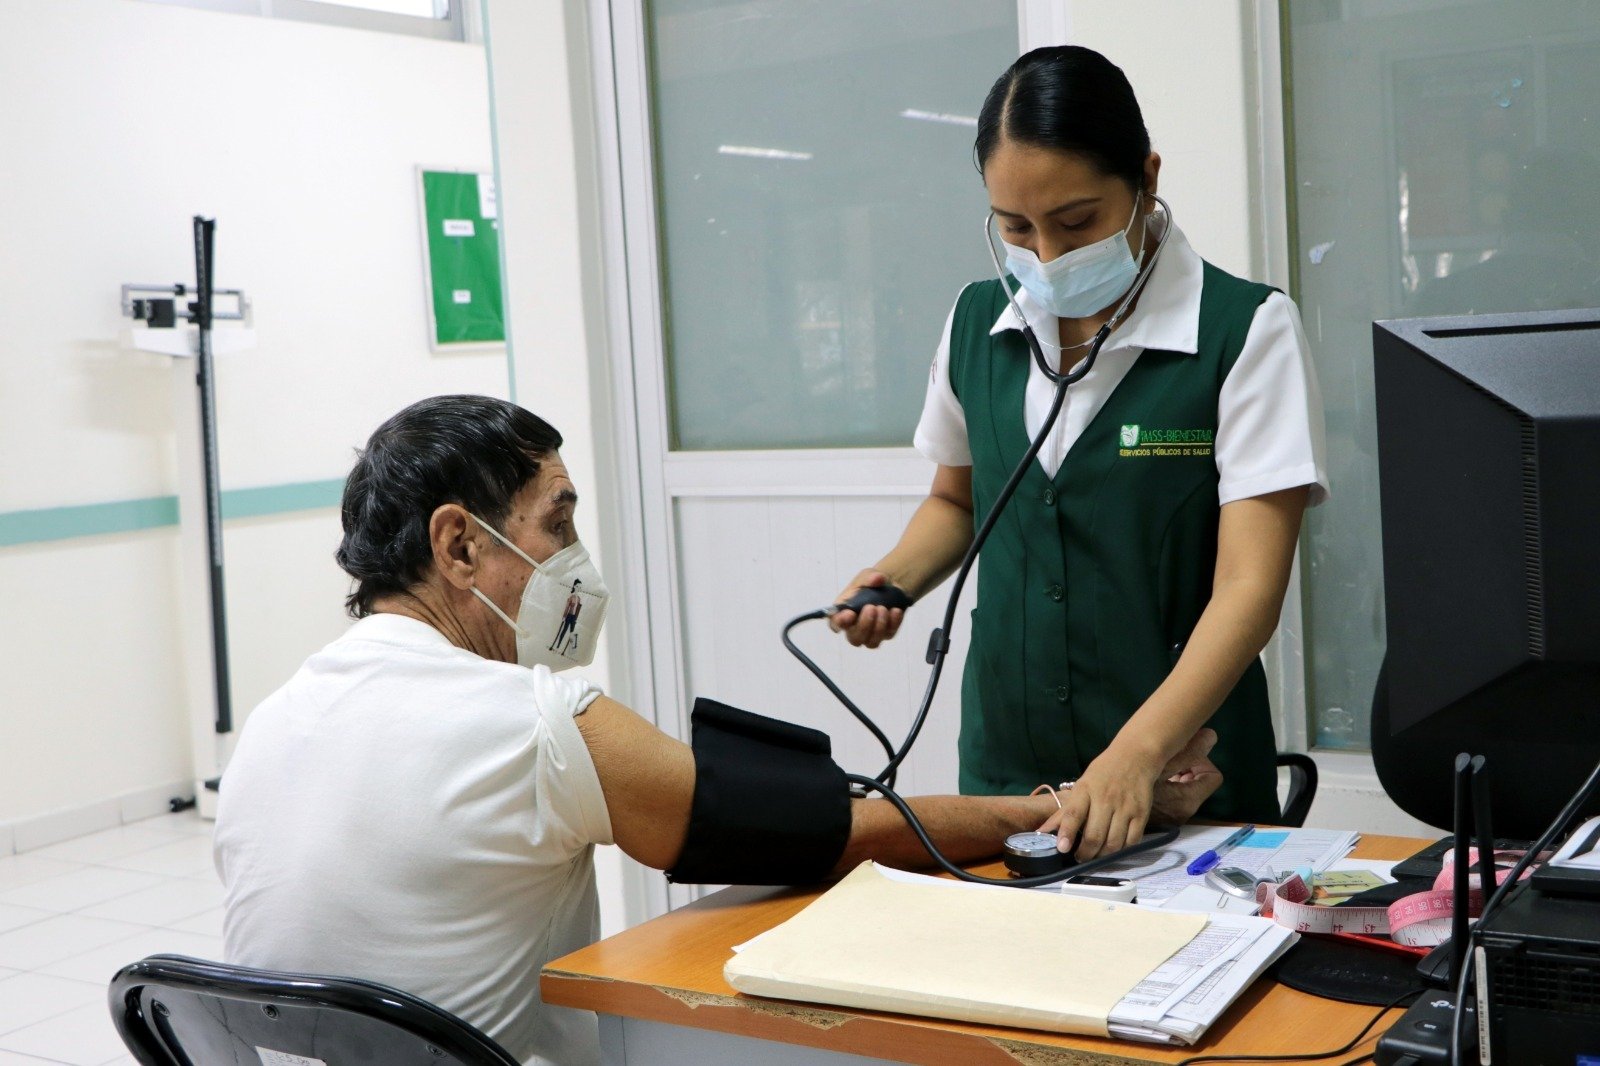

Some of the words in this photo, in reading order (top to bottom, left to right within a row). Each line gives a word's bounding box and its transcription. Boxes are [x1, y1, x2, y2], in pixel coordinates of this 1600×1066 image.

[1119, 449, 1150, 457] SERVICIOS
[1152, 447, 1181, 456] PÚBLICOS
[1183, 448, 1191, 456] DE
[1193, 448, 1211, 456] SALUD
[1418, 901, 1427, 911] 85
[1432, 899, 1441, 908] 86
[1299, 922, 1310, 931] 45
[1333, 924, 1343, 932] 44
[1364, 924, 1376, 933] 43
[1407, 937, 1418, 946] 31
